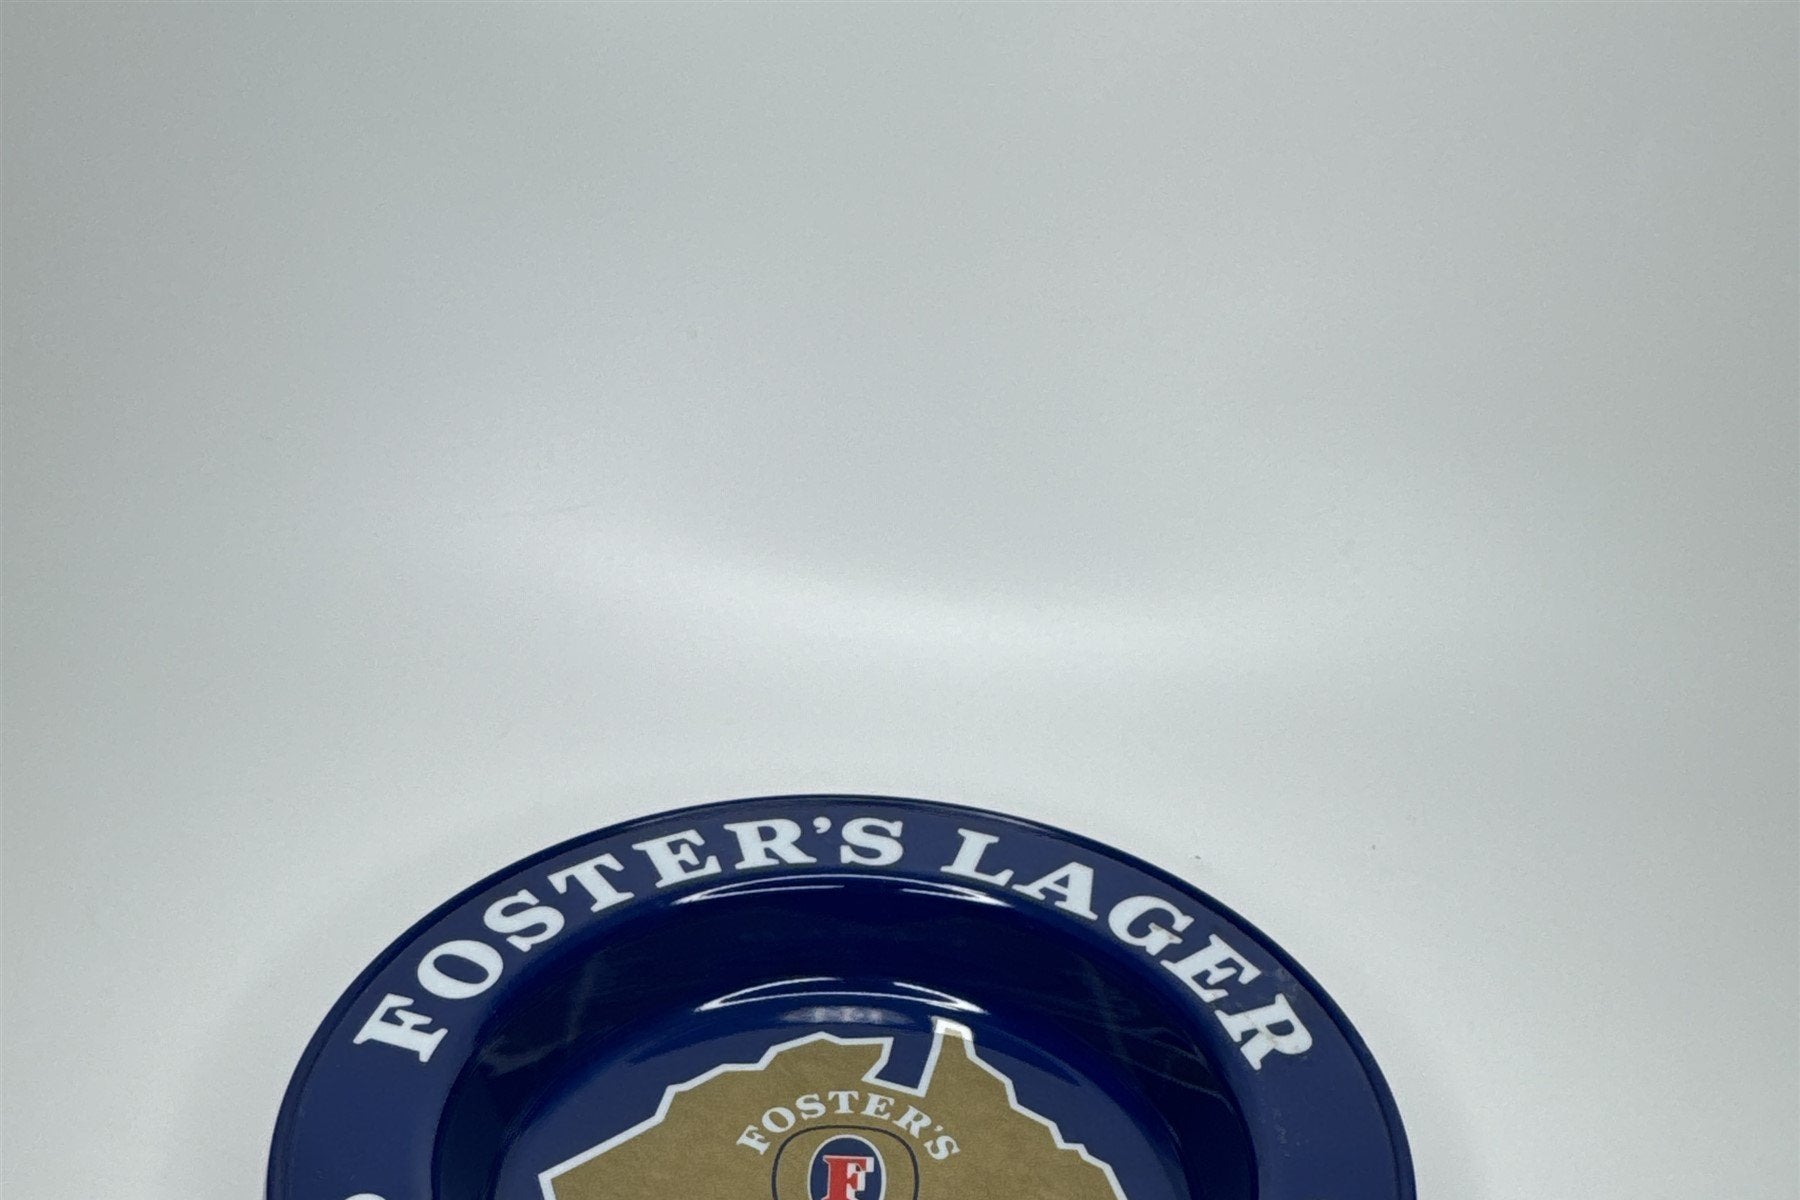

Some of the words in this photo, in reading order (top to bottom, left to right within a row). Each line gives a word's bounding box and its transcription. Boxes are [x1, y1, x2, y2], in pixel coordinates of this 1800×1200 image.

[353, 816, 904, 1063] FOSTER'S
[940, 827, 1314, 1071] LAGER
[736, 1090, 961, 1160] FOSTER'S
